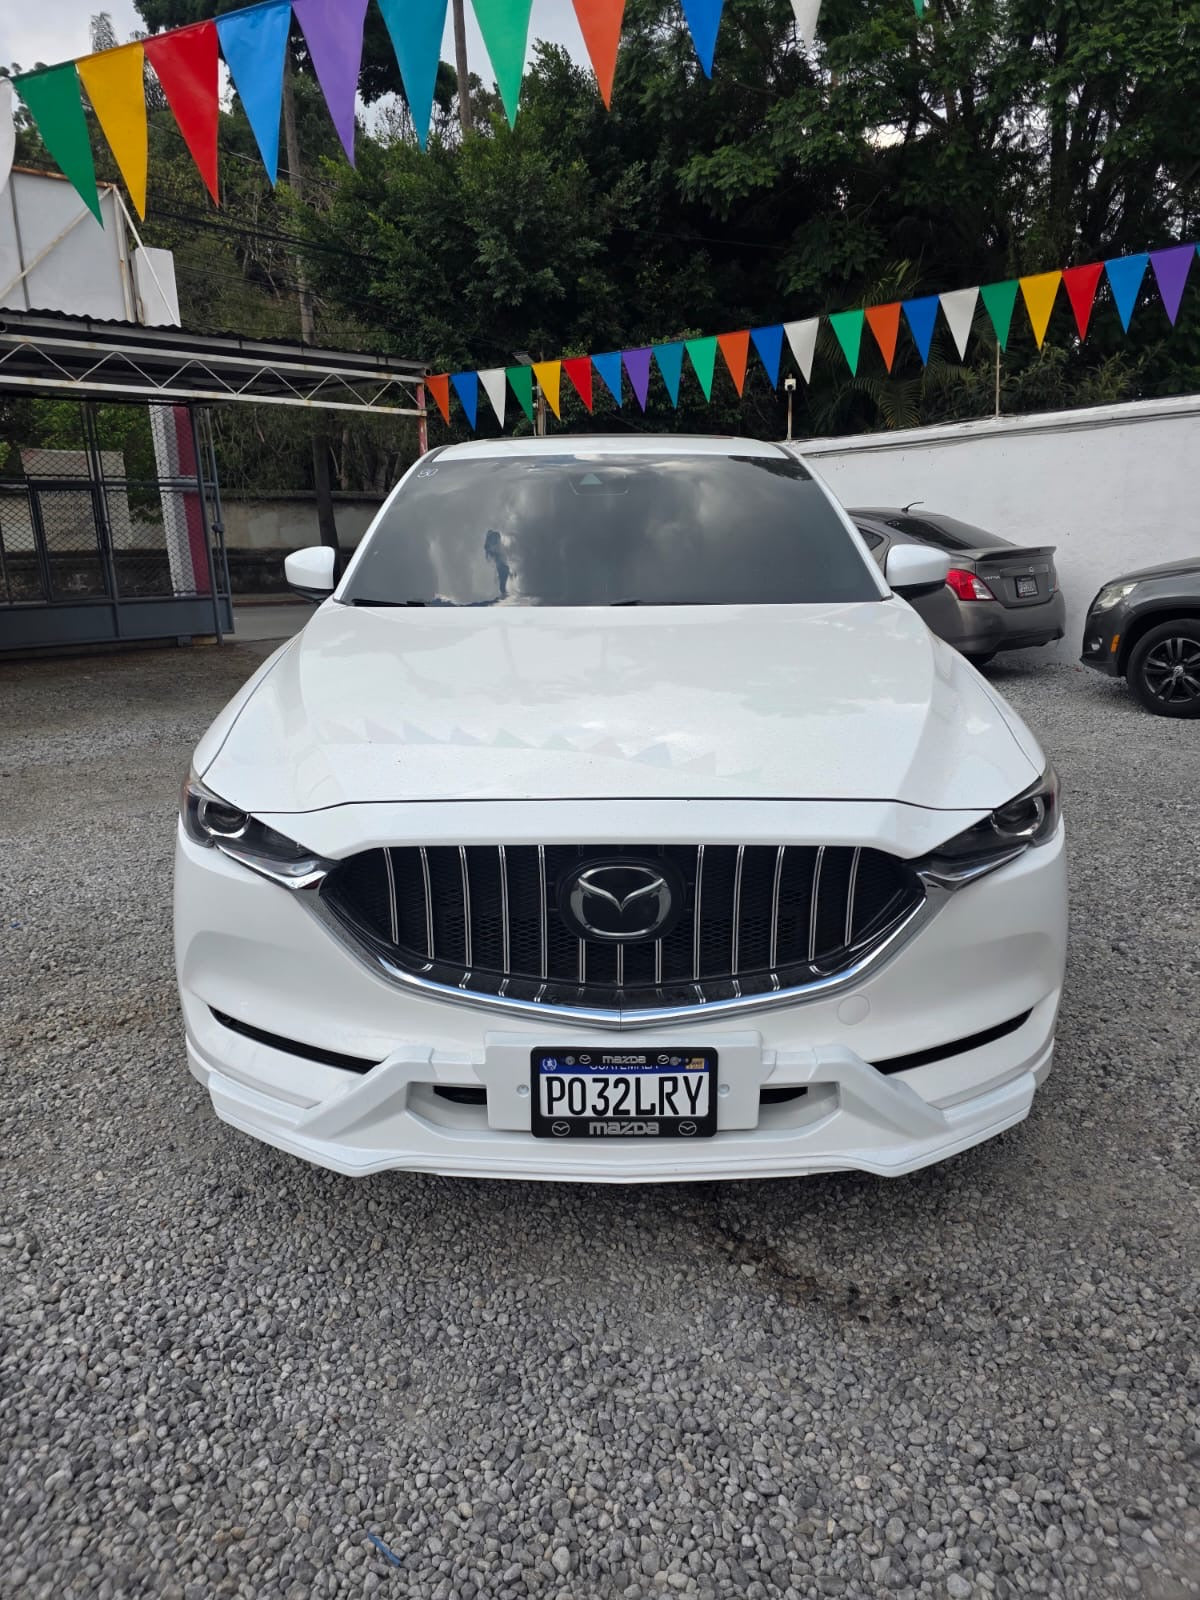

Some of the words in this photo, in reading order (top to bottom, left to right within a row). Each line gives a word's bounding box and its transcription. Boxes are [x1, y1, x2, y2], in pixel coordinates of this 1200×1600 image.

[602, 1055, 647, 1064] mazda
[545, 1075, 704, 1117] P032LRY
[589, 1121, 660, 1136] mazda
